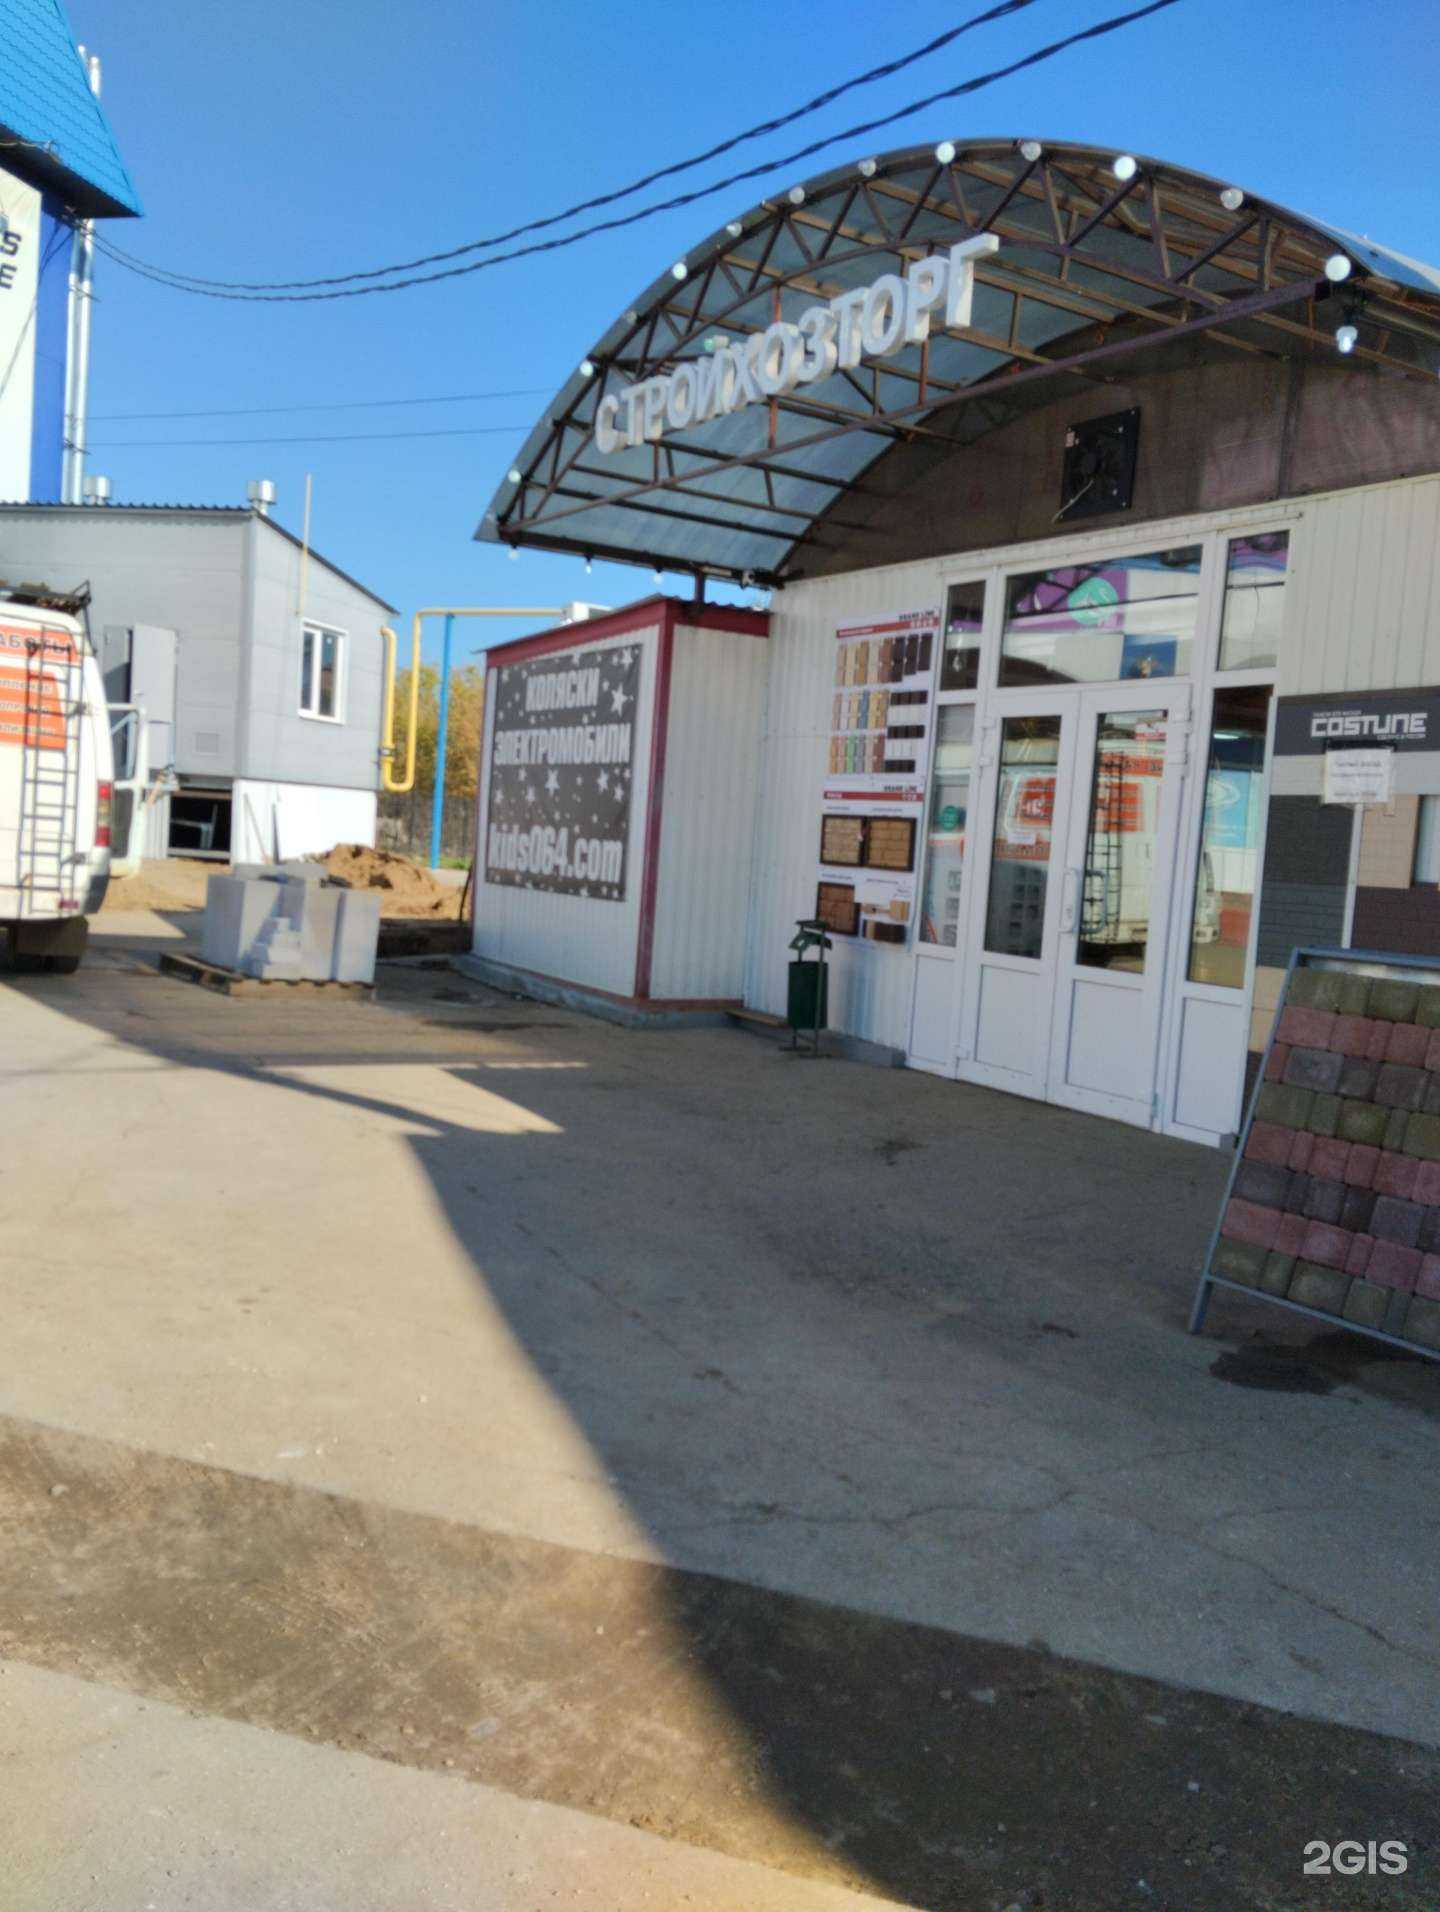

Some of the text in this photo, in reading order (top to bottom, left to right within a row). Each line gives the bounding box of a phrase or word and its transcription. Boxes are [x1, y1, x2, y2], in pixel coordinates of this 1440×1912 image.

[595, 233, 999, 454] СТРОЙХОЗТОРГ
[525, 667, 600, 712] КОЛЯСКИ
[494, 723, 631, 765] ЭЛЕКТРОМОБИЛИ
[1311, 712, 1428, 737] COSTUNE
[488, 822, 623, 883] kids064.com
